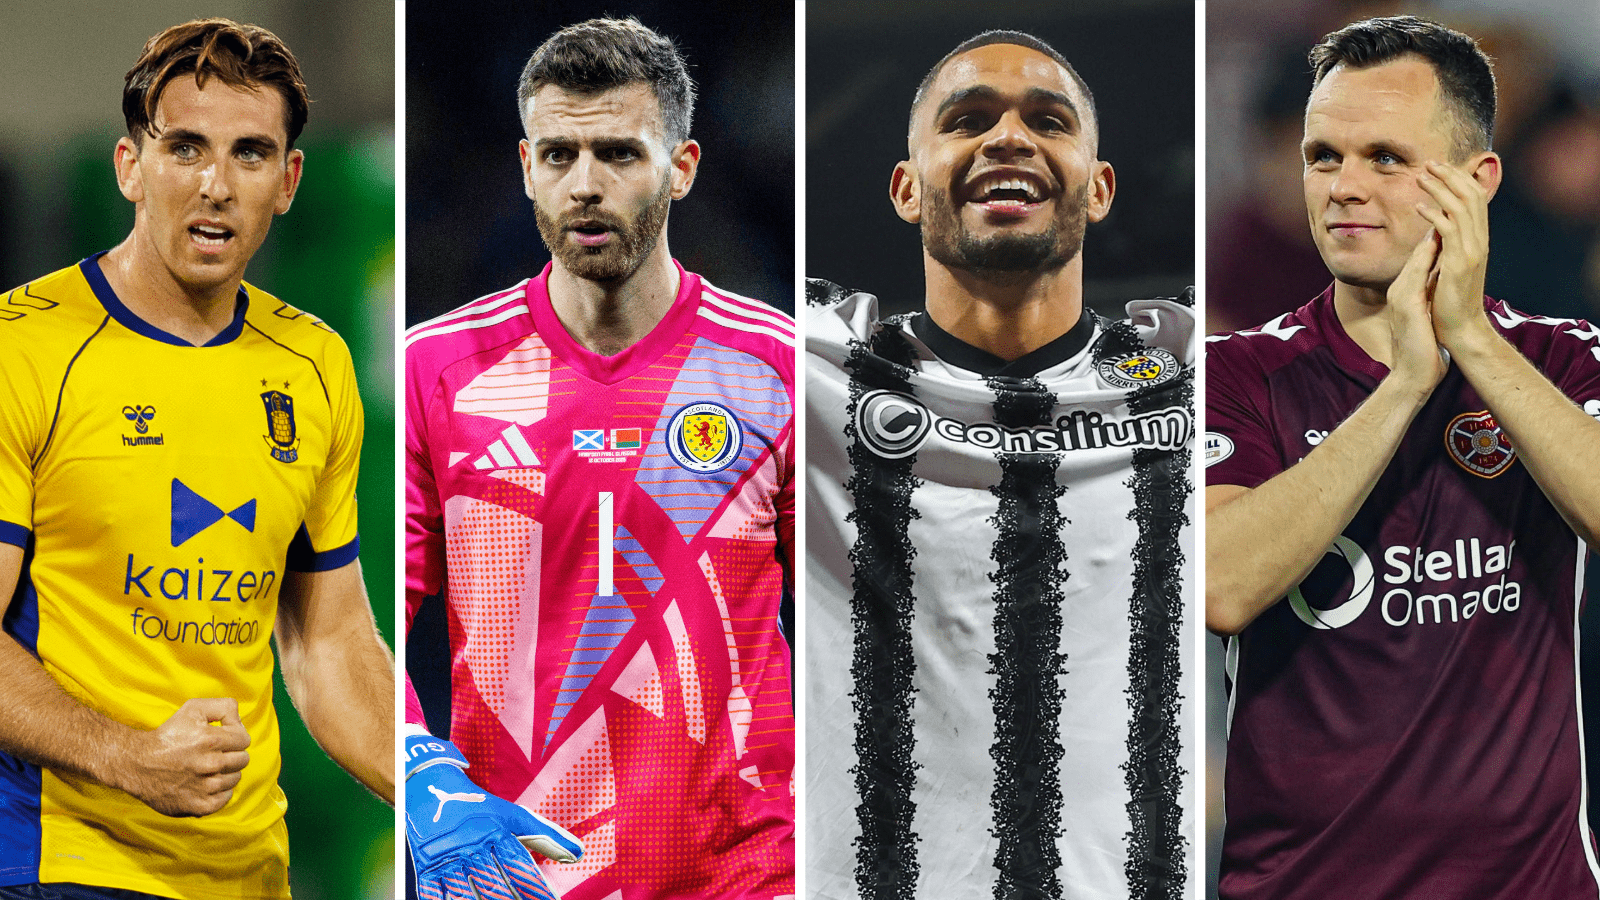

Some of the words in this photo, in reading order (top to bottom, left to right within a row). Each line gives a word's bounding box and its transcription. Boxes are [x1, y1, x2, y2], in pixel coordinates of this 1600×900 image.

[687, 404, 723, 415] SCOTLAND
[935, 410, 1189, 453] consilium
[122, 433, 164, 446] hummel
[598, 491, 614, 597] 1
[1383, 537, 1516, 585] Stellar
[124, 553, 276, 603] kaizen
[1381, 573, 1521, 627] Omada
[130, 606, 259, 646] foundation
